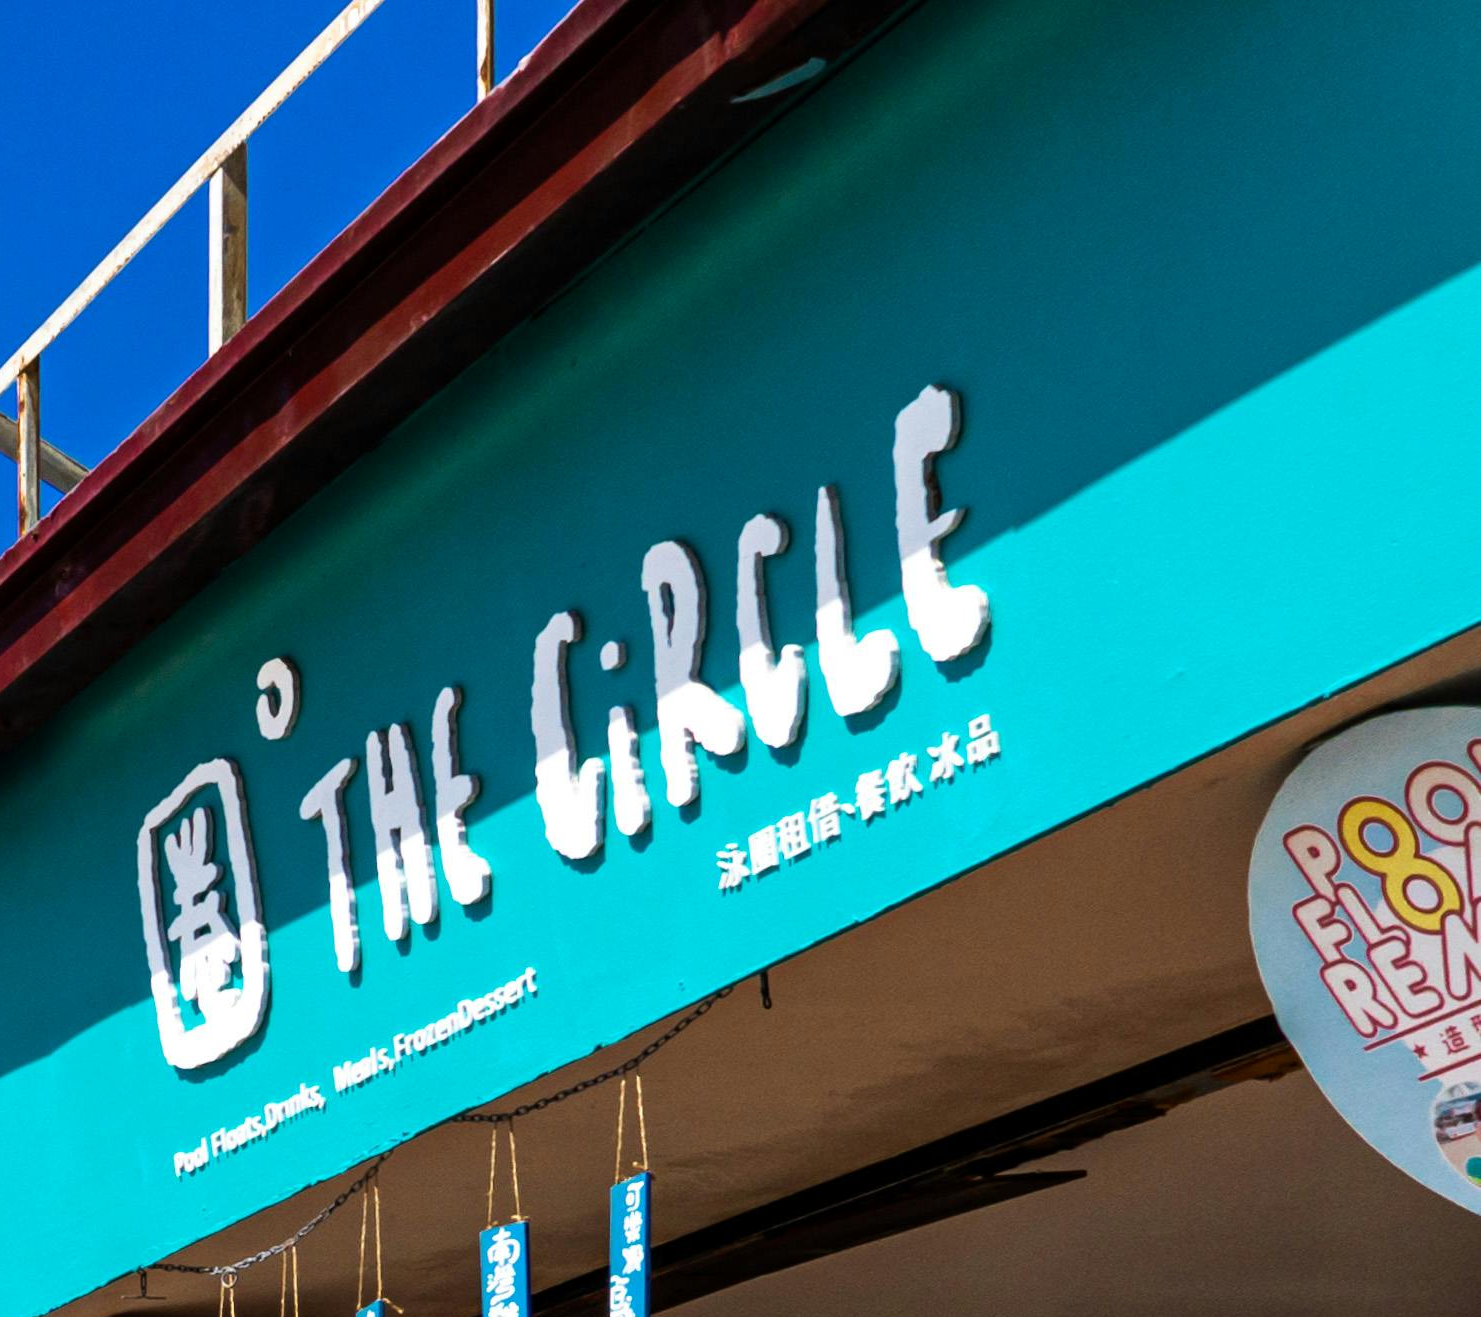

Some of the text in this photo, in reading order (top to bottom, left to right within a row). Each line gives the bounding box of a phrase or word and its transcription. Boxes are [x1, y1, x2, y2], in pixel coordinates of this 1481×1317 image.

[926, 713, 1001, 783] 冰品
[299, 686, 491, 973] THE
[173, 1138, 206, 1177] Pool
